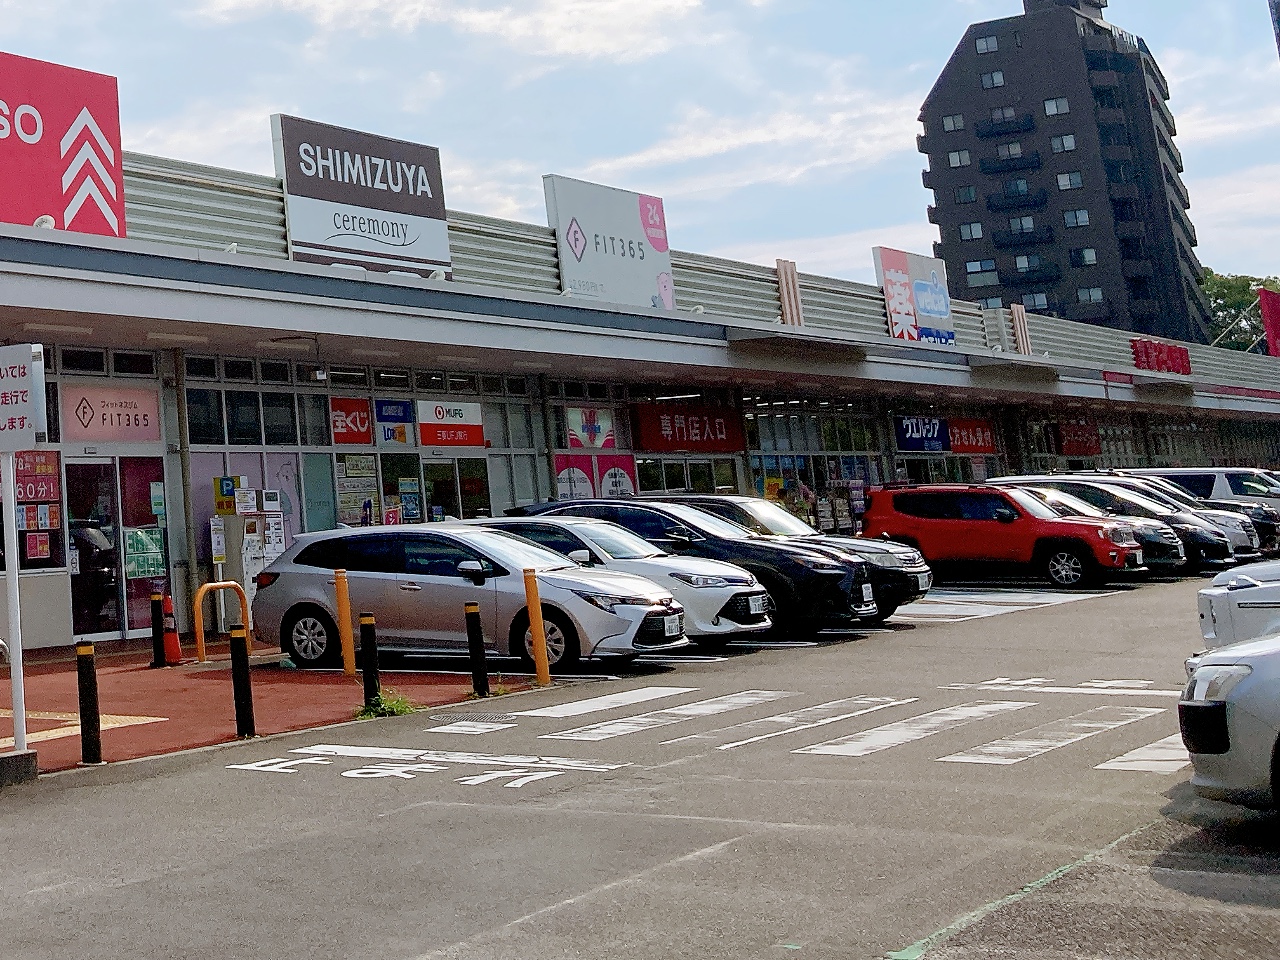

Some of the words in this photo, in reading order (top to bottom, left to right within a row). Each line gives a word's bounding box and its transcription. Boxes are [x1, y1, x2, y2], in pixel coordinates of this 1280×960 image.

[298, 141, 433, 199] SHIMIZUYA
[332, 209, 410, 242] ceremony
[593, 233, 645, 261] FIT365
[885, 268, 918, 341] 薬
[101, 413, 149, 427] FIT365
[331, 410, 369, 434] 宝くじ
[445, 408, 464, 419] MUFG
